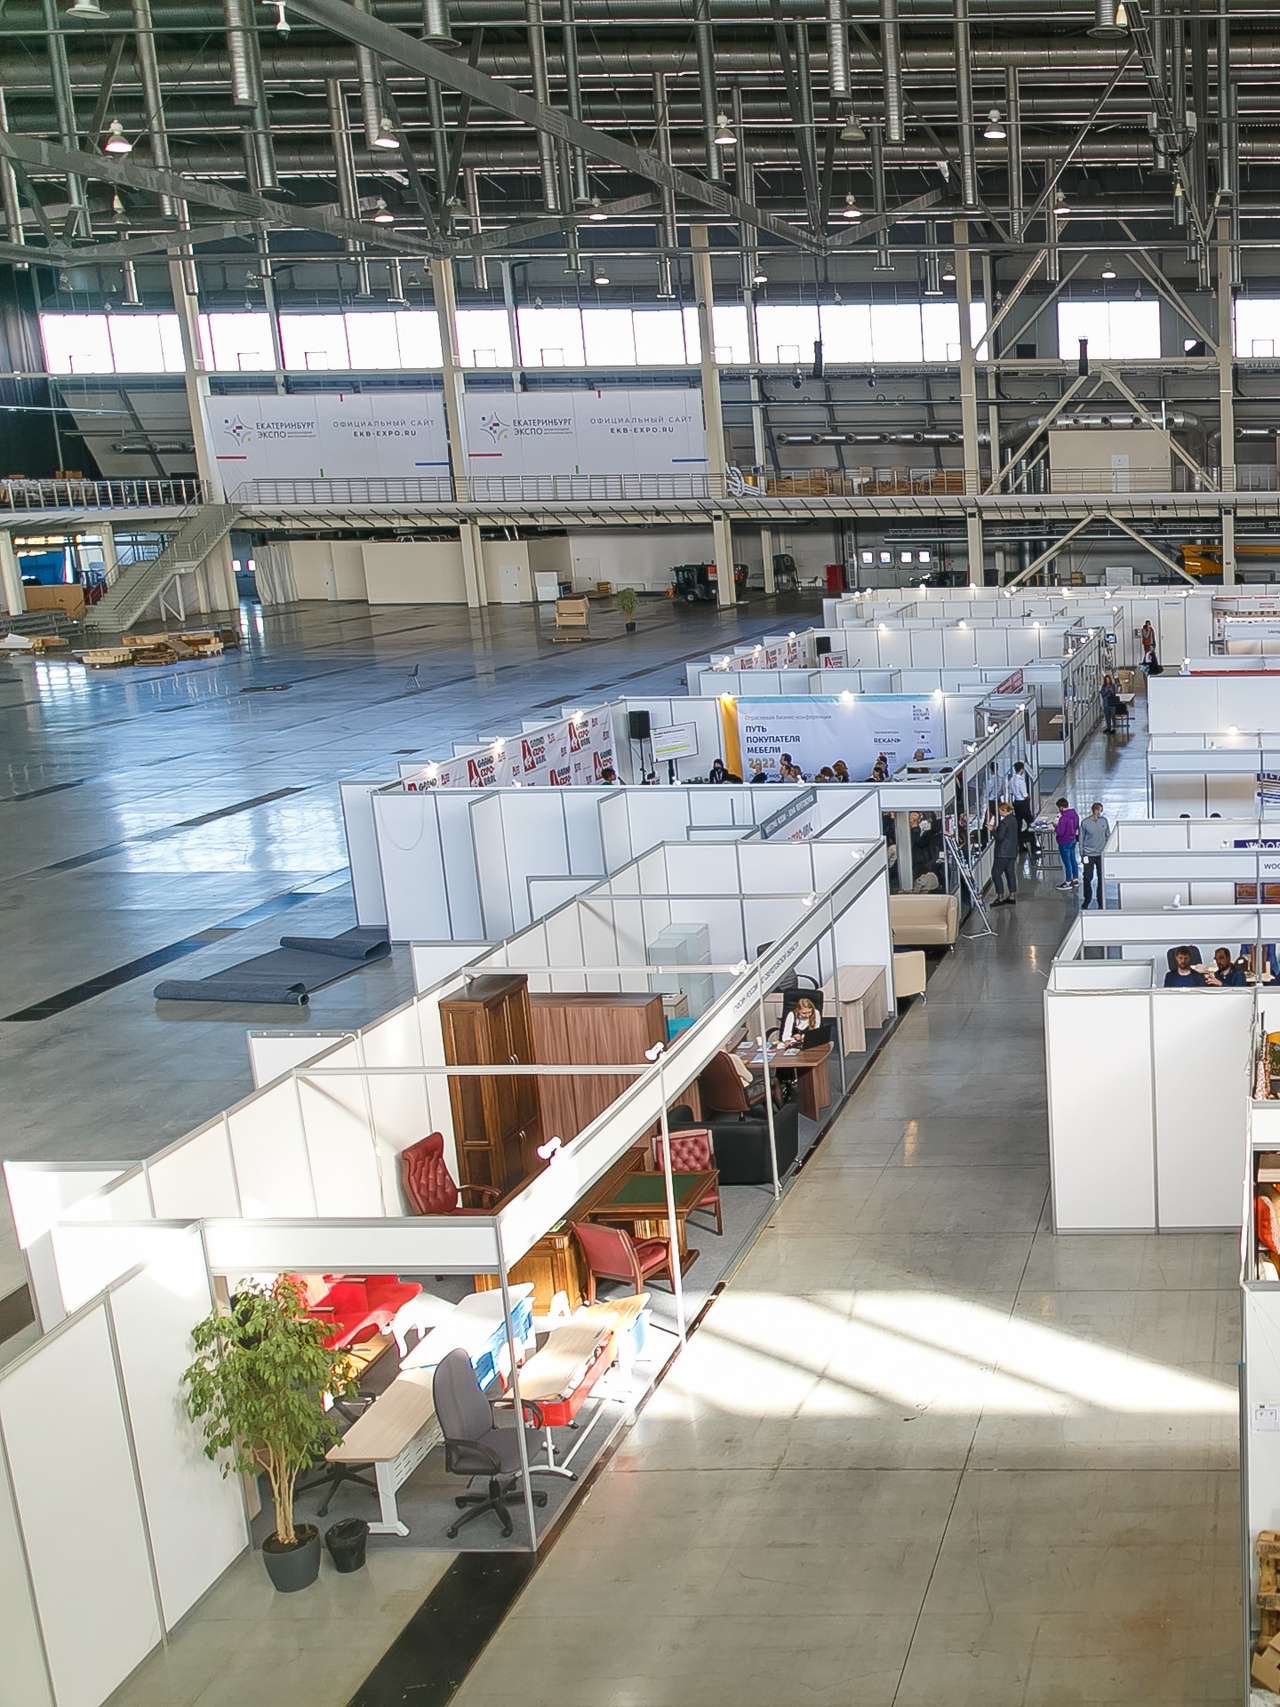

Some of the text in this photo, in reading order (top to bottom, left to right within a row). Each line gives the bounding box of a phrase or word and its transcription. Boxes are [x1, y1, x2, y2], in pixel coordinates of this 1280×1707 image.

[332, 420, 407, 428] ОФИЦИАЛЬНЫЙ
[512, 418, 572, 427] ЕКАТЕРИНБУРГ
[590, 416, 692, 425] ОФИЦИАЛЬНЫЙ САЙТ
[256, 422, 315, 430] ЕКАТЕРИНБУРГ
[257, 431, 287, 439] ЭКСПО
[353, 430, 417, 438] EKB-EXPO.RU
[514, 428, 543, 436] ЭКСПО
[746, 735, 800, 743] ПОКУПАТЕЛЯ
[747, 746, 781, 754] МЕБЕЛИ
[748, 758, 776, 768] 2022
